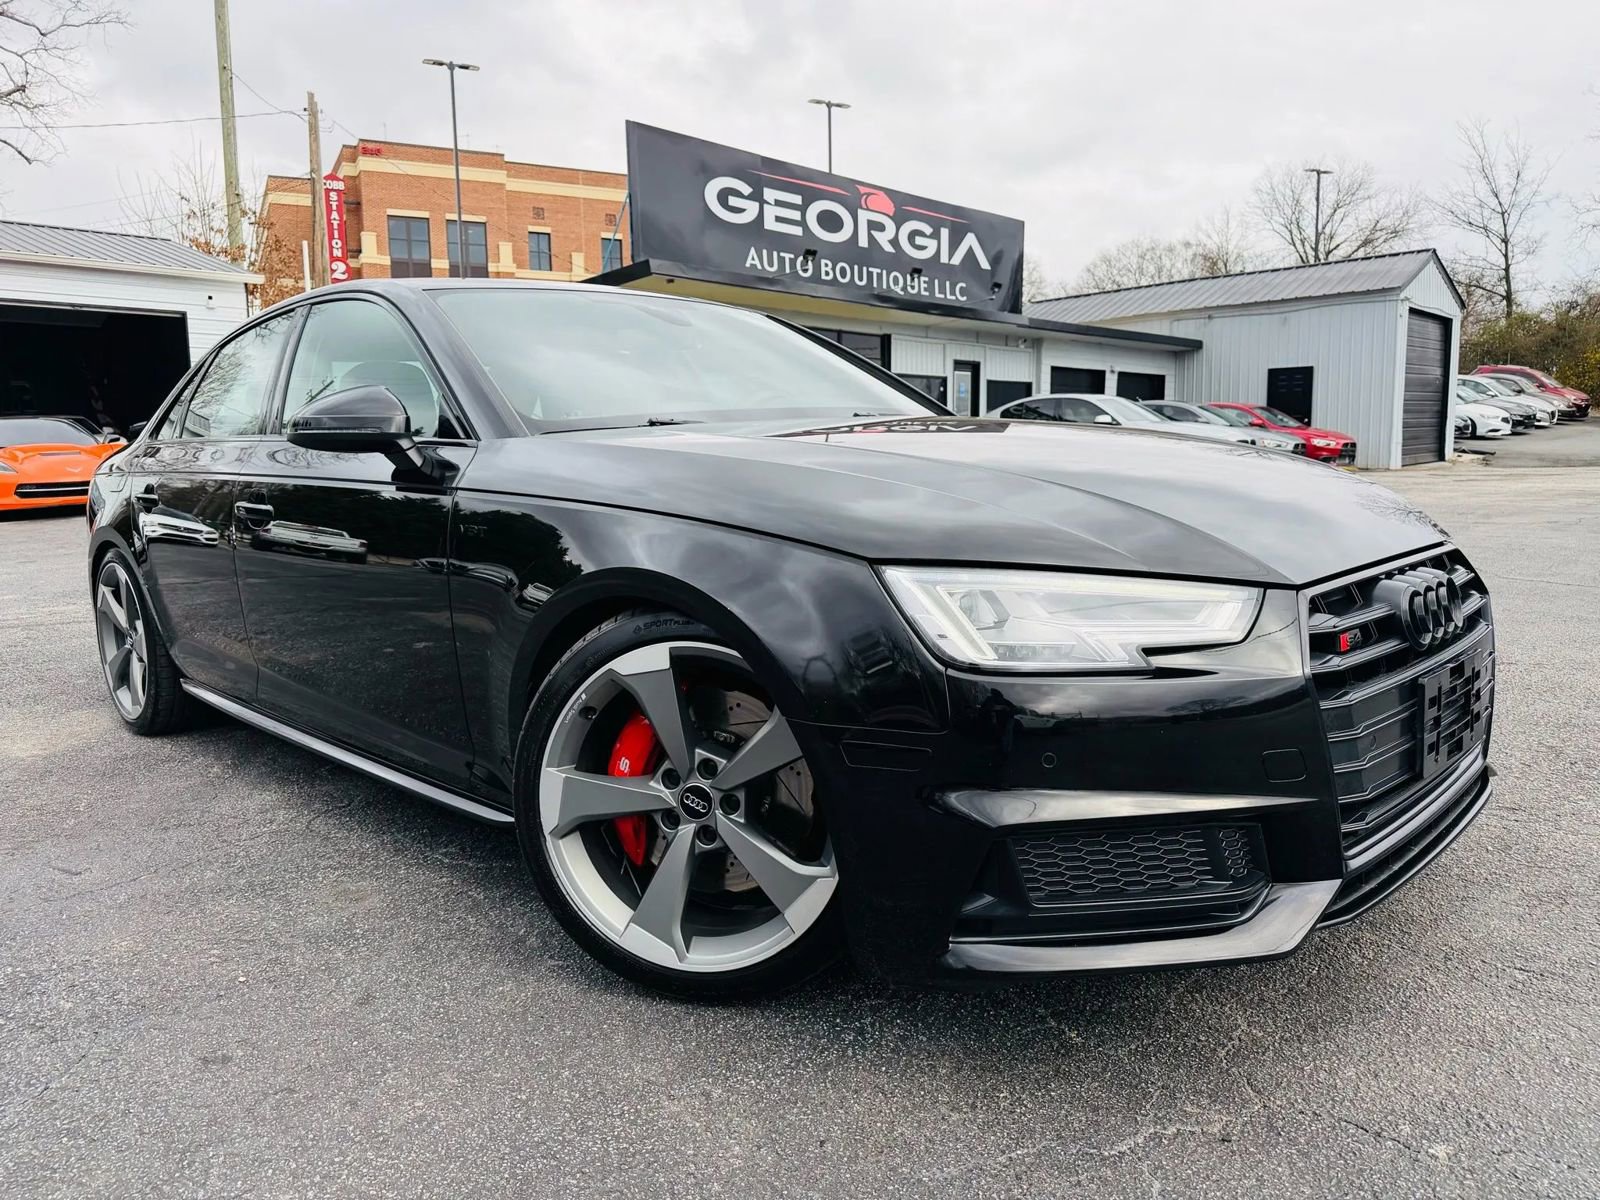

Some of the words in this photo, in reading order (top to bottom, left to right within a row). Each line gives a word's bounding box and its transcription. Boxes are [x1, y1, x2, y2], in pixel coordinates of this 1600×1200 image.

[329, 191, 343, 257] STATION
[703, 176, 991, 271] GEORGIA
[330, 260, 349, 280] 2
[745, 246, 814, 277] AUTO
[820, 259, 930, 295] BOUTIQUE
[934, 278, 967, 301] LLC
[619, 756, 630, 773] S
